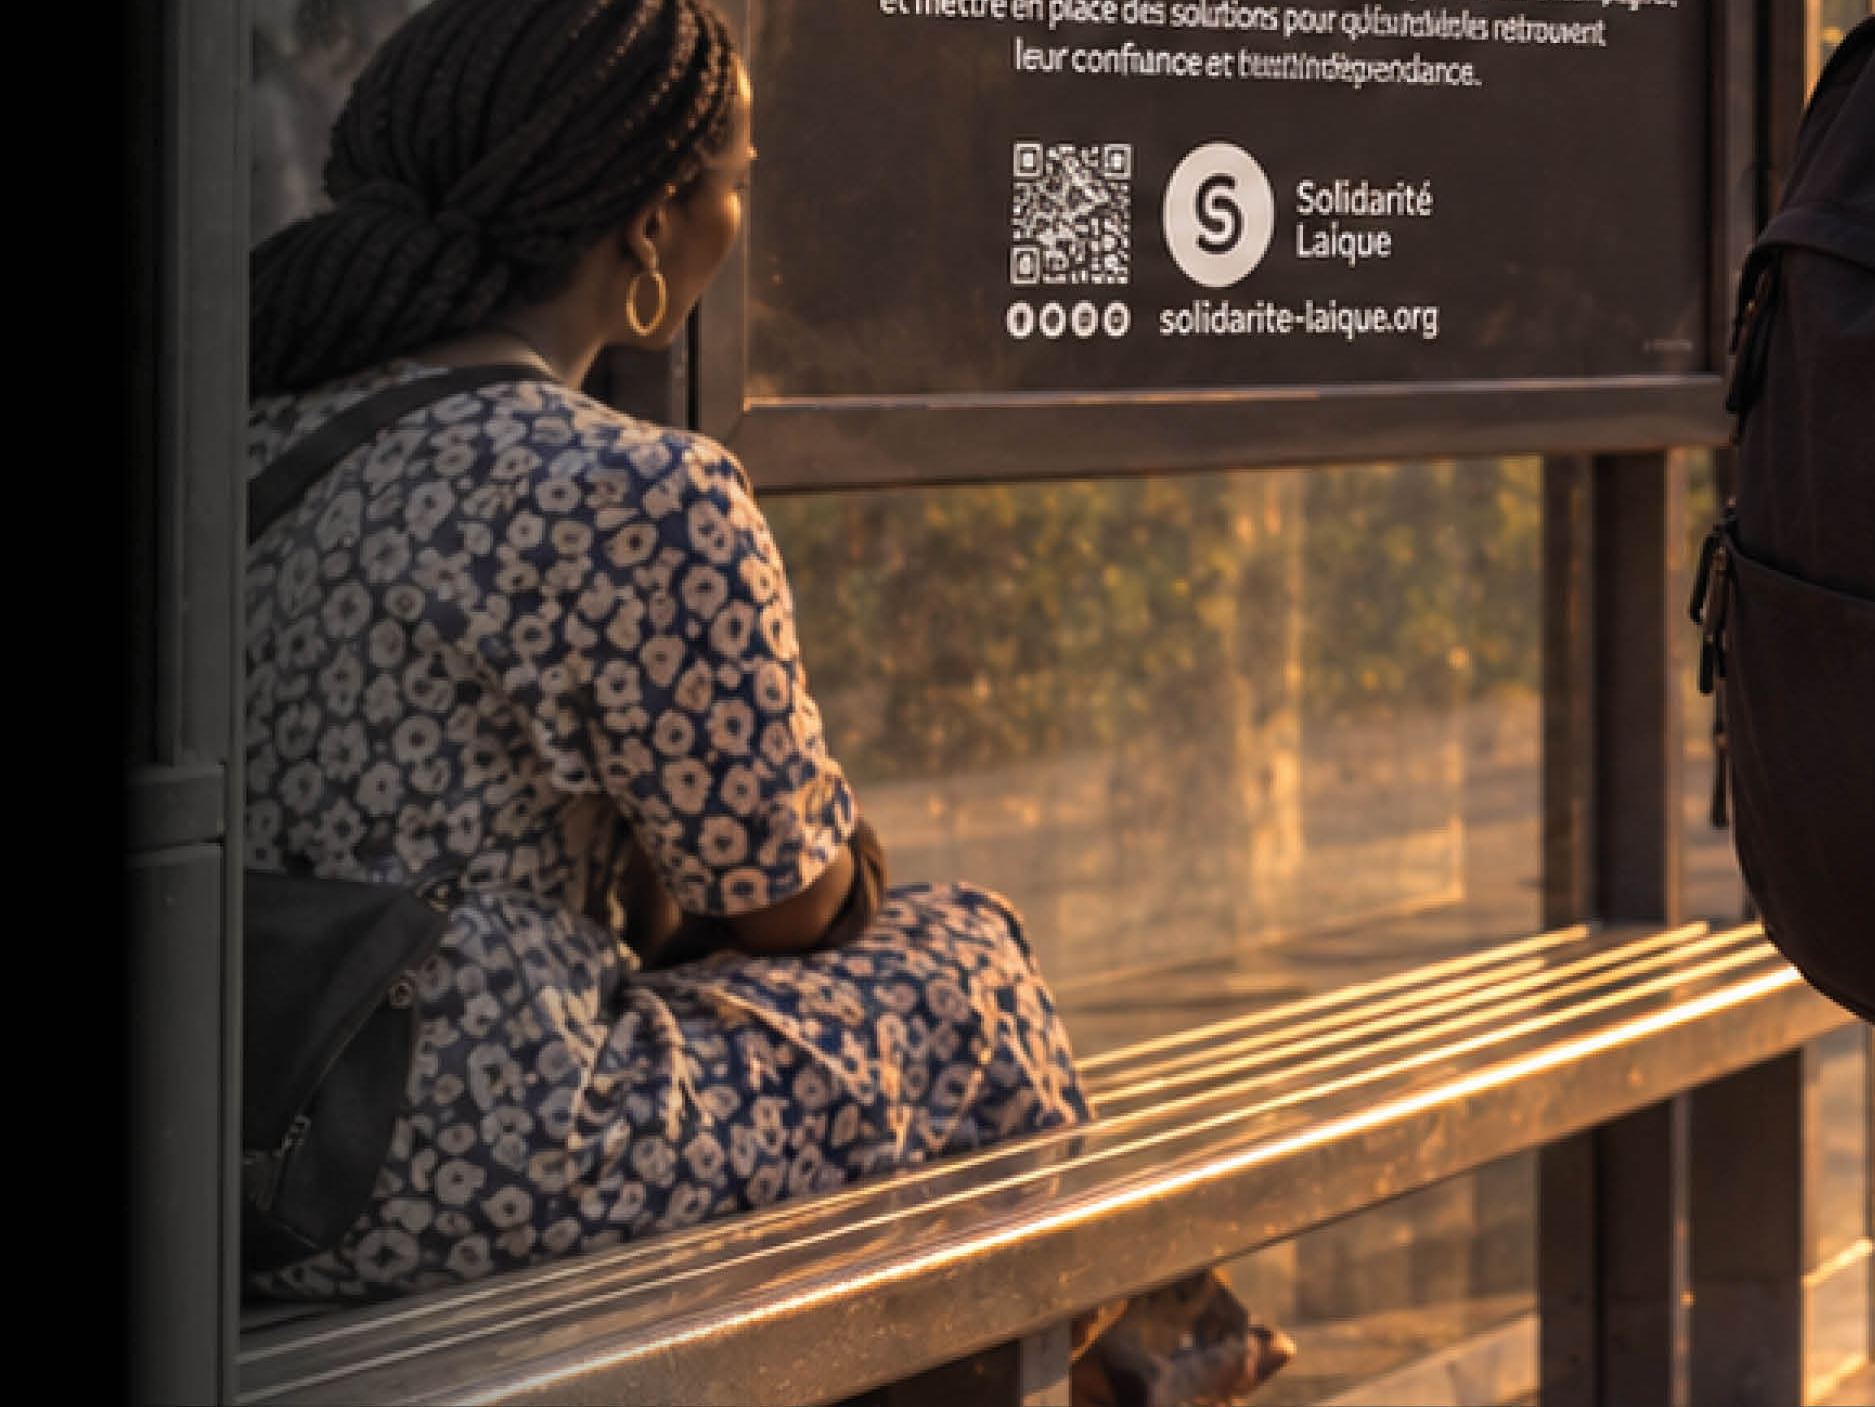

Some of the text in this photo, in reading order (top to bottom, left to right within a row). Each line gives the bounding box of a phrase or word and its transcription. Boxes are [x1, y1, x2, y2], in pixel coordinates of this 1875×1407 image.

[1283, 10, 1337, 37] pour
[1015, 36, 1070, 73] leur
[1204, 50, 1234, 79] et
[1196, 173, 1243, 253] S
[1296, 179, 1433, 217] Solidarité
[1159, 299, 1440, 340] solidarite-laique.org
